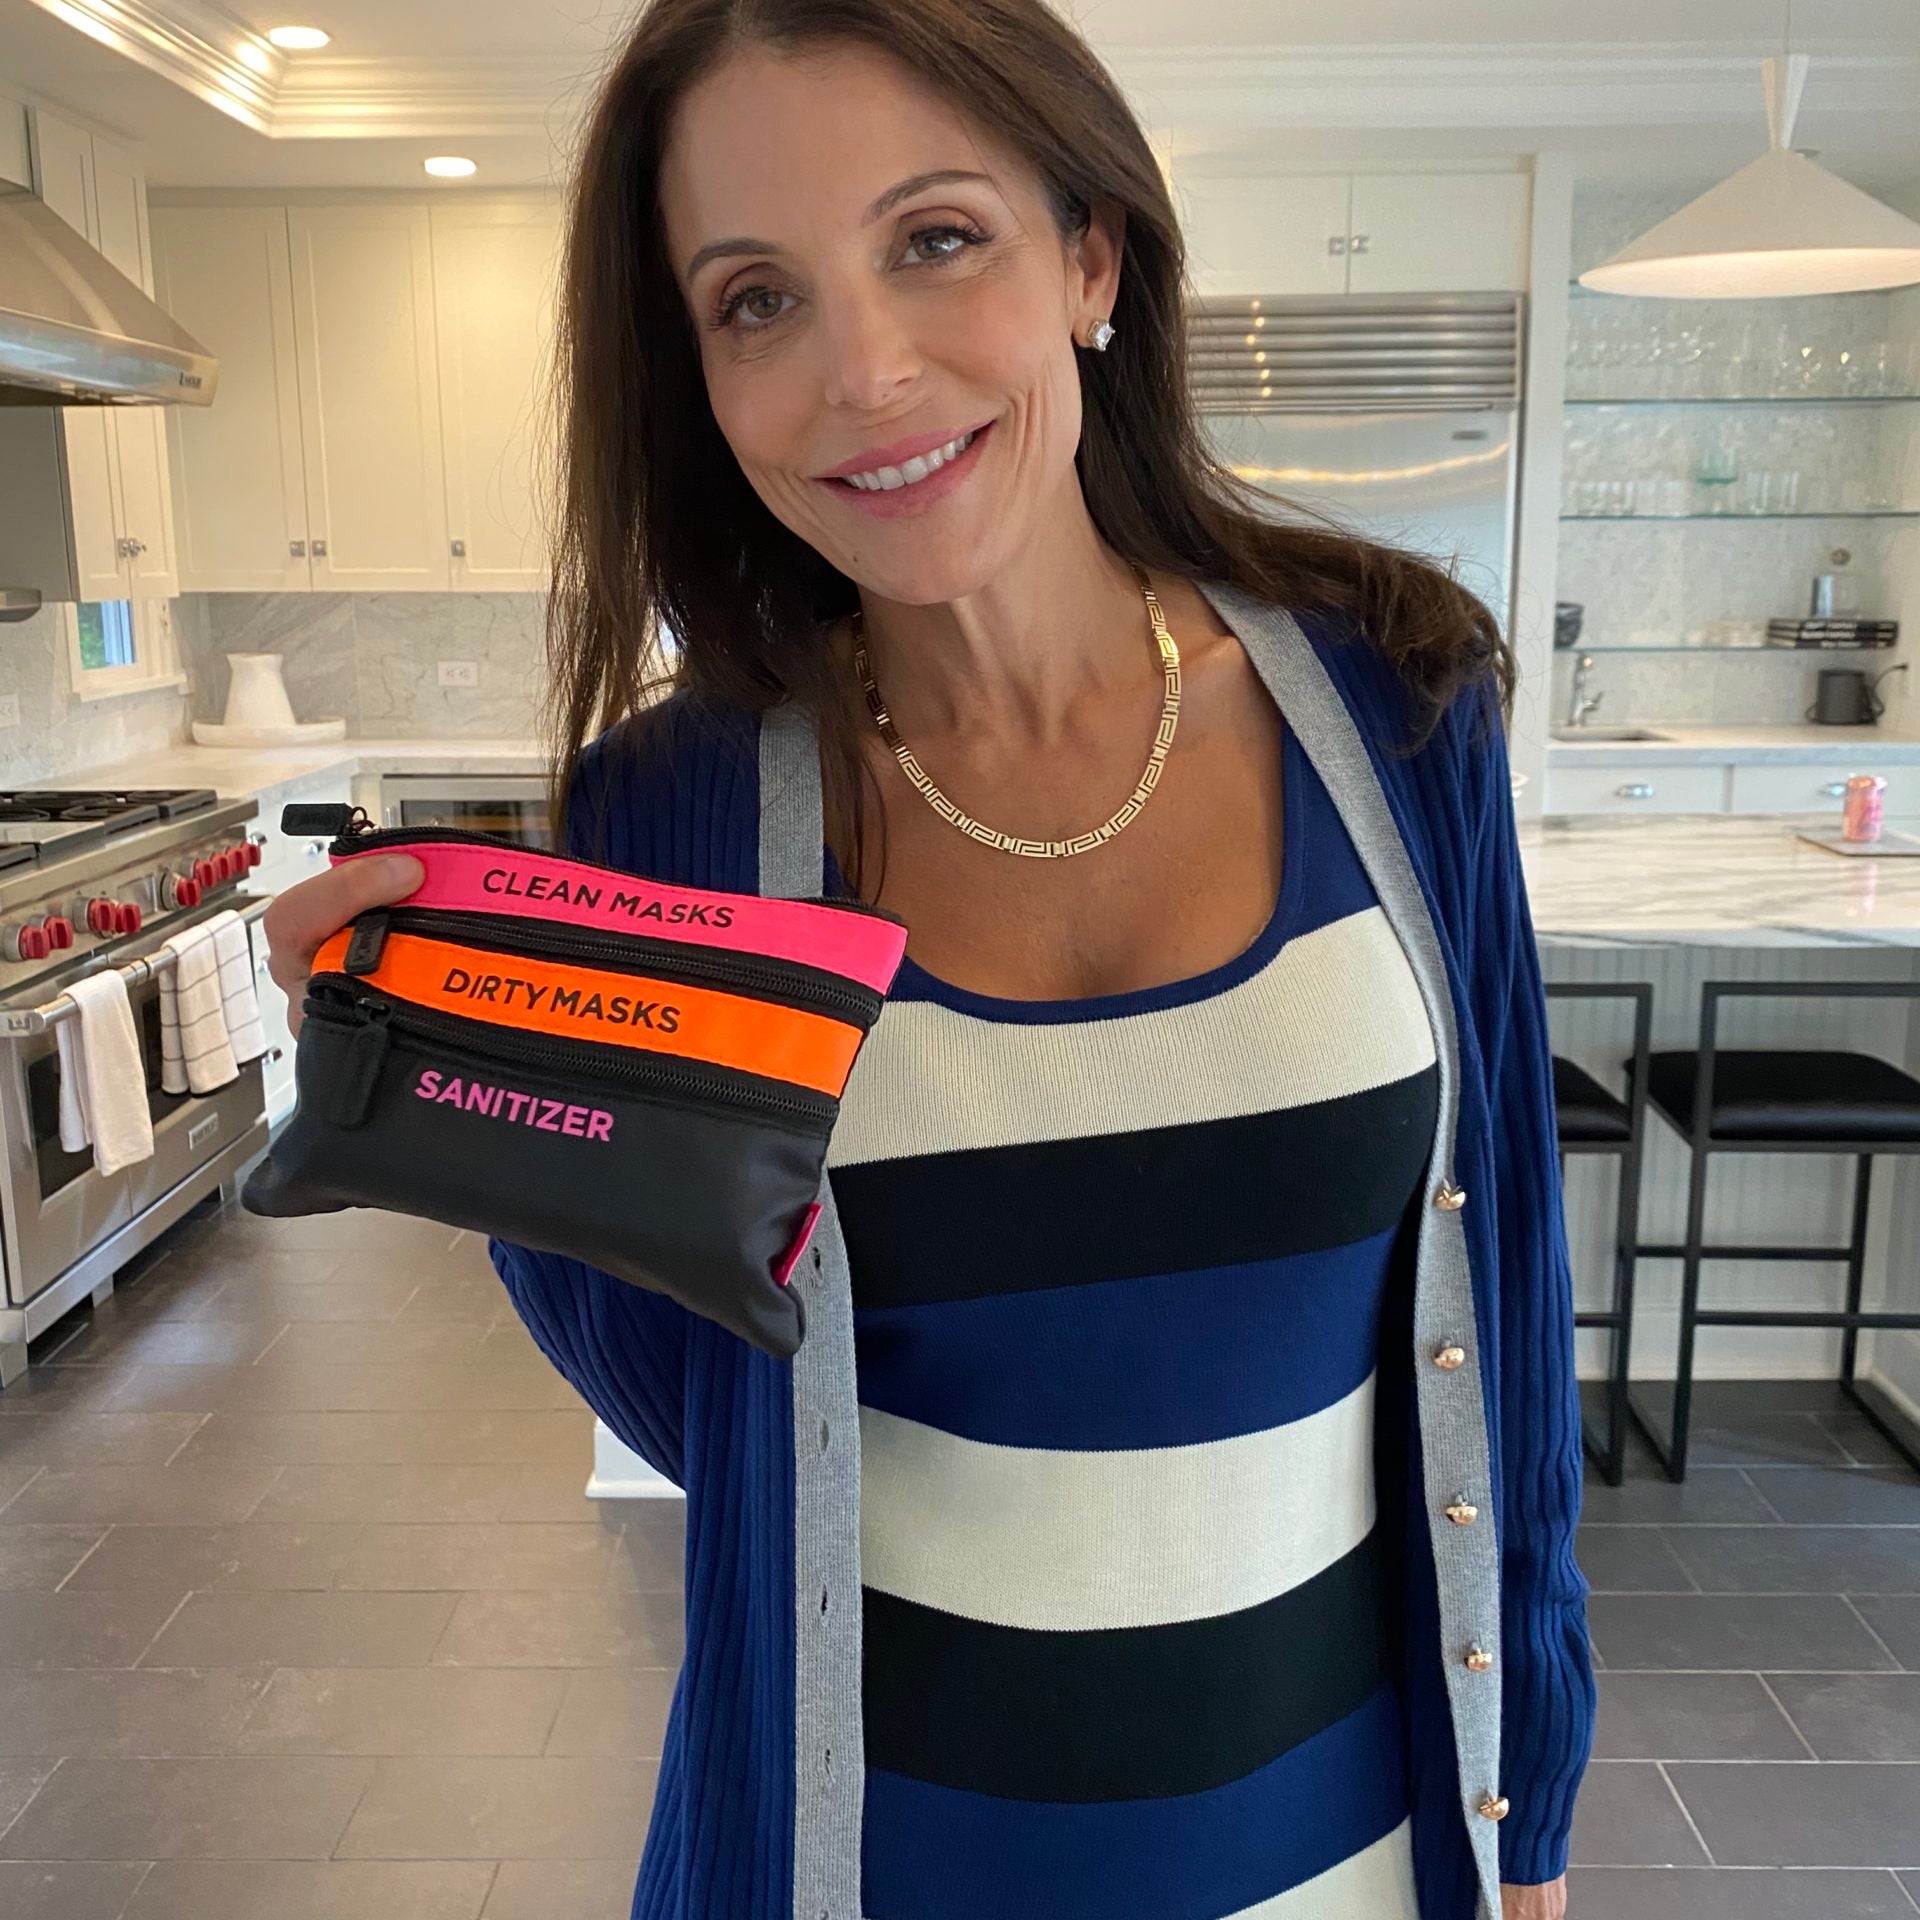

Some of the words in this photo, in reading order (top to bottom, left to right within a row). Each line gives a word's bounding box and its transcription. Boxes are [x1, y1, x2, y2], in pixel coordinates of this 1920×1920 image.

[483, 869, 602, 909] CLEAN
[610, 891, 734, 928] MASKS
[443, 968, 548, 1010] DIRTY
[550, 987, 680, 1033] MASKS
[415, 1070, 613, 1141] SANITIZER
